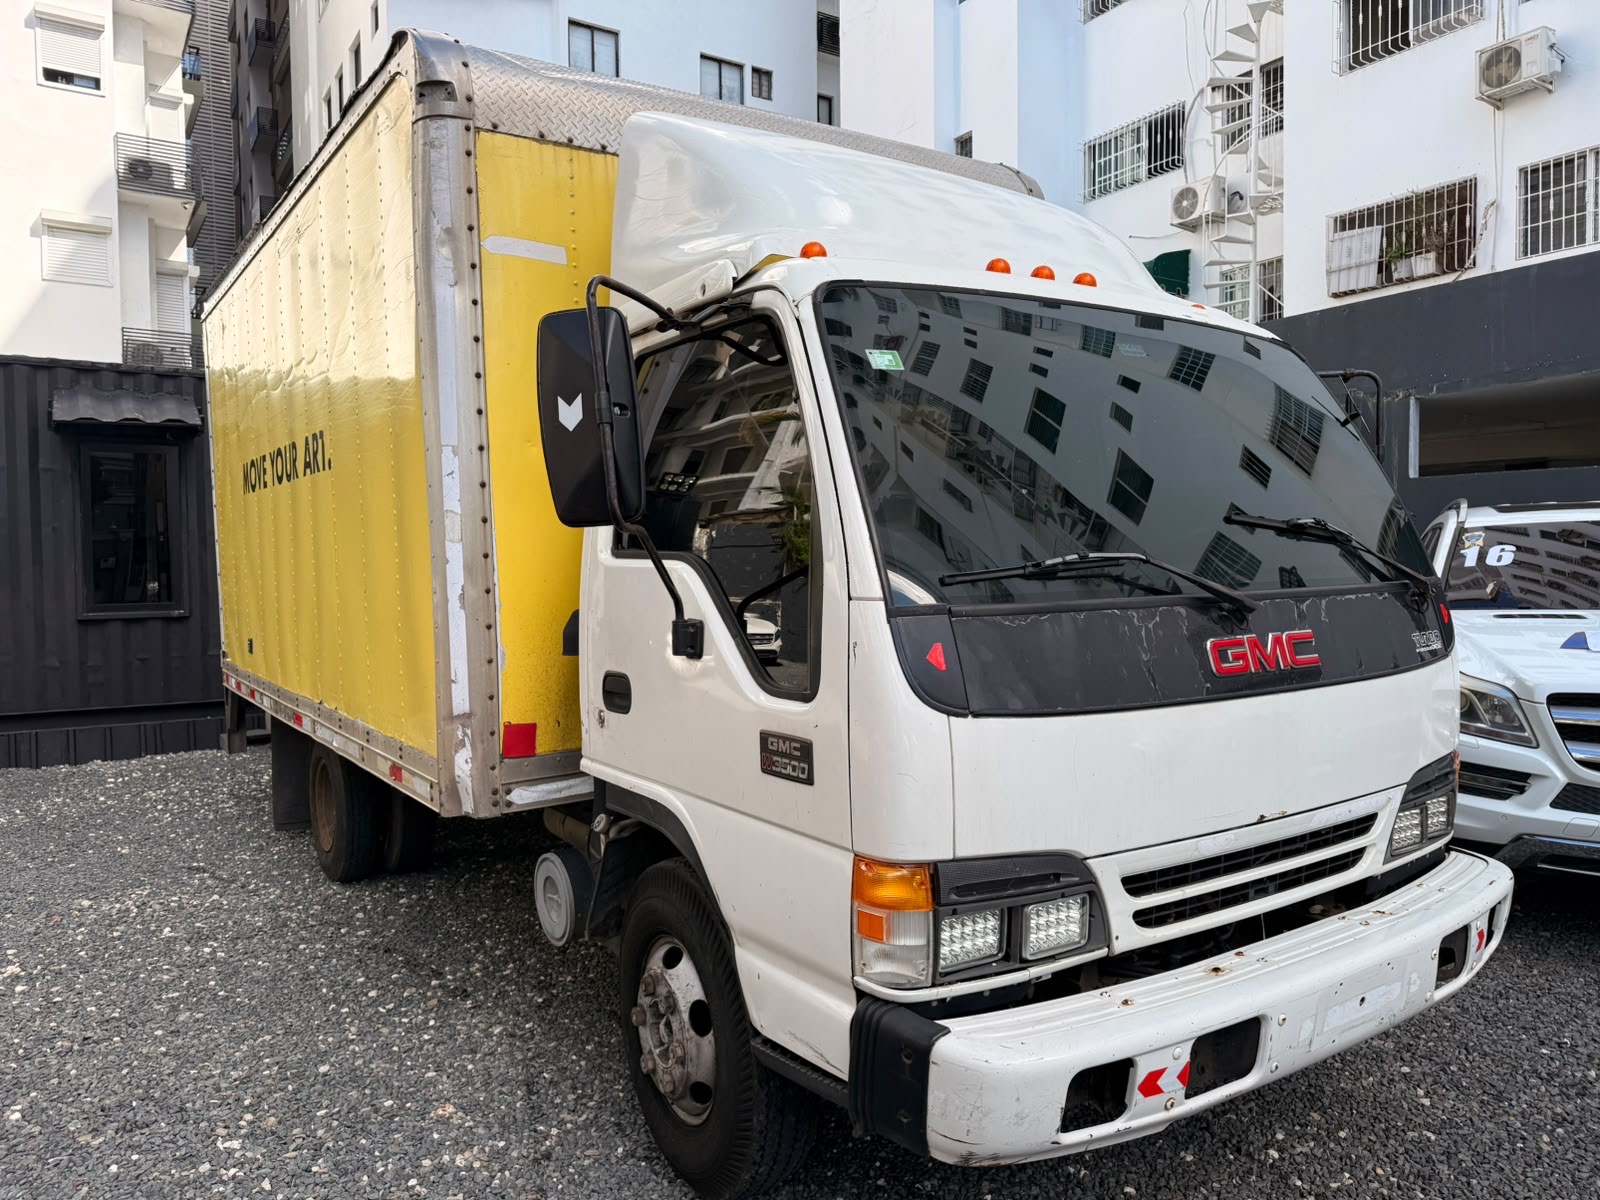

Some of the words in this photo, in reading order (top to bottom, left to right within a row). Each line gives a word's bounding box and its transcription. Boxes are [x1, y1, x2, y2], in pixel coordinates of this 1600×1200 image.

[243, 454, 268, 495] MOVE
[269, 441, 299, 486] YOUR
[303, 429, 332, 477] ART.
[1460, 544, 1517, 567] 16
[1206, 629, 1321, 677] GMC
[767, 737, 801, 756] GMC
